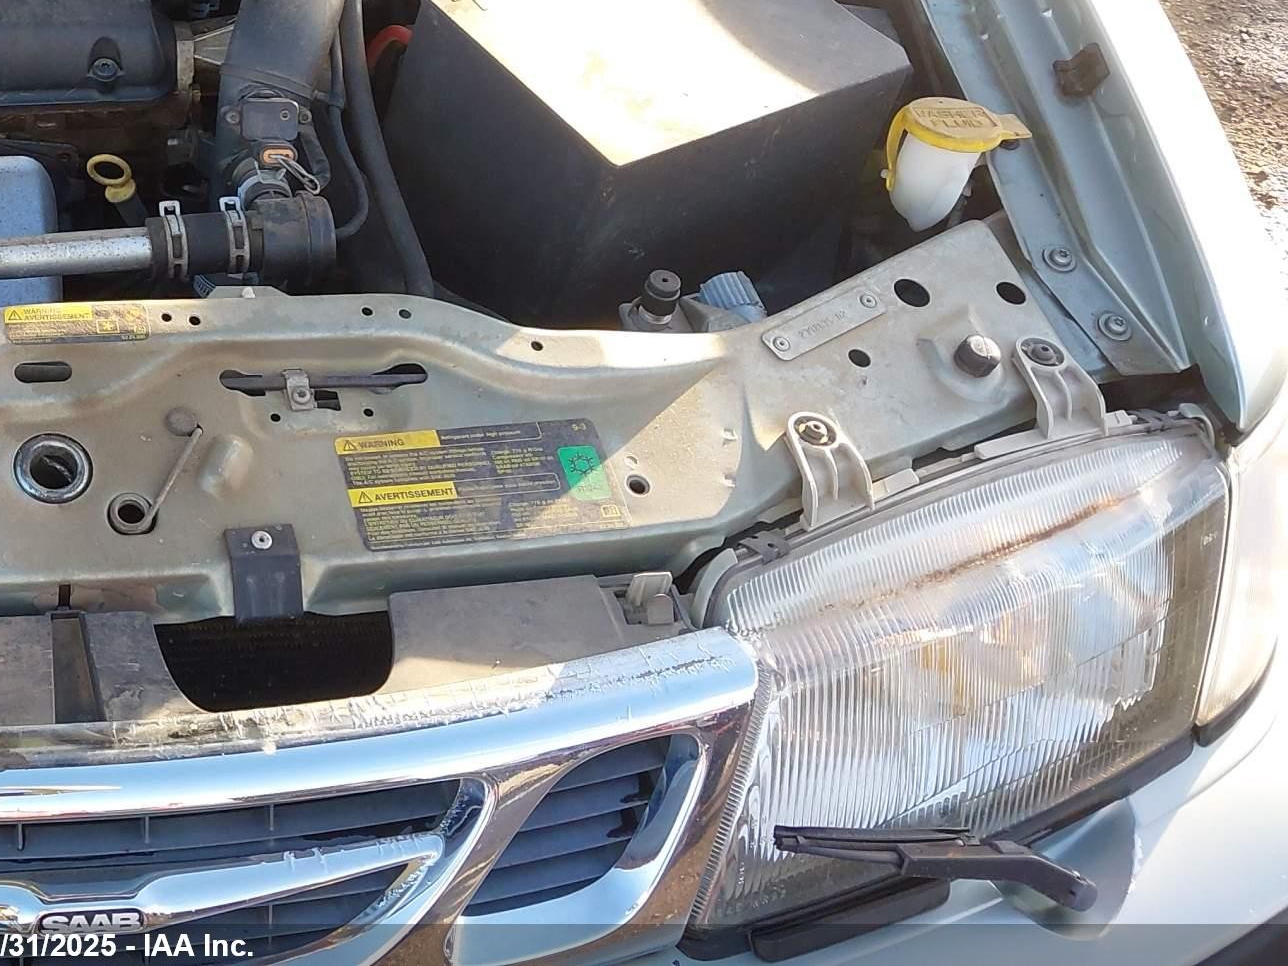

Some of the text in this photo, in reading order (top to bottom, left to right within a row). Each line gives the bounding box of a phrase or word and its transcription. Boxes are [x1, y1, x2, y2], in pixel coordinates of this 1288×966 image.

[914, 108, 987, 119] WASHER
[929, 118, 984, 129] FLUID
[358, 438, 405, 450] WARNING
[374, 487, 454, 502] AVERTISSEMENT
[41, 912, 142, 932] SAAB
